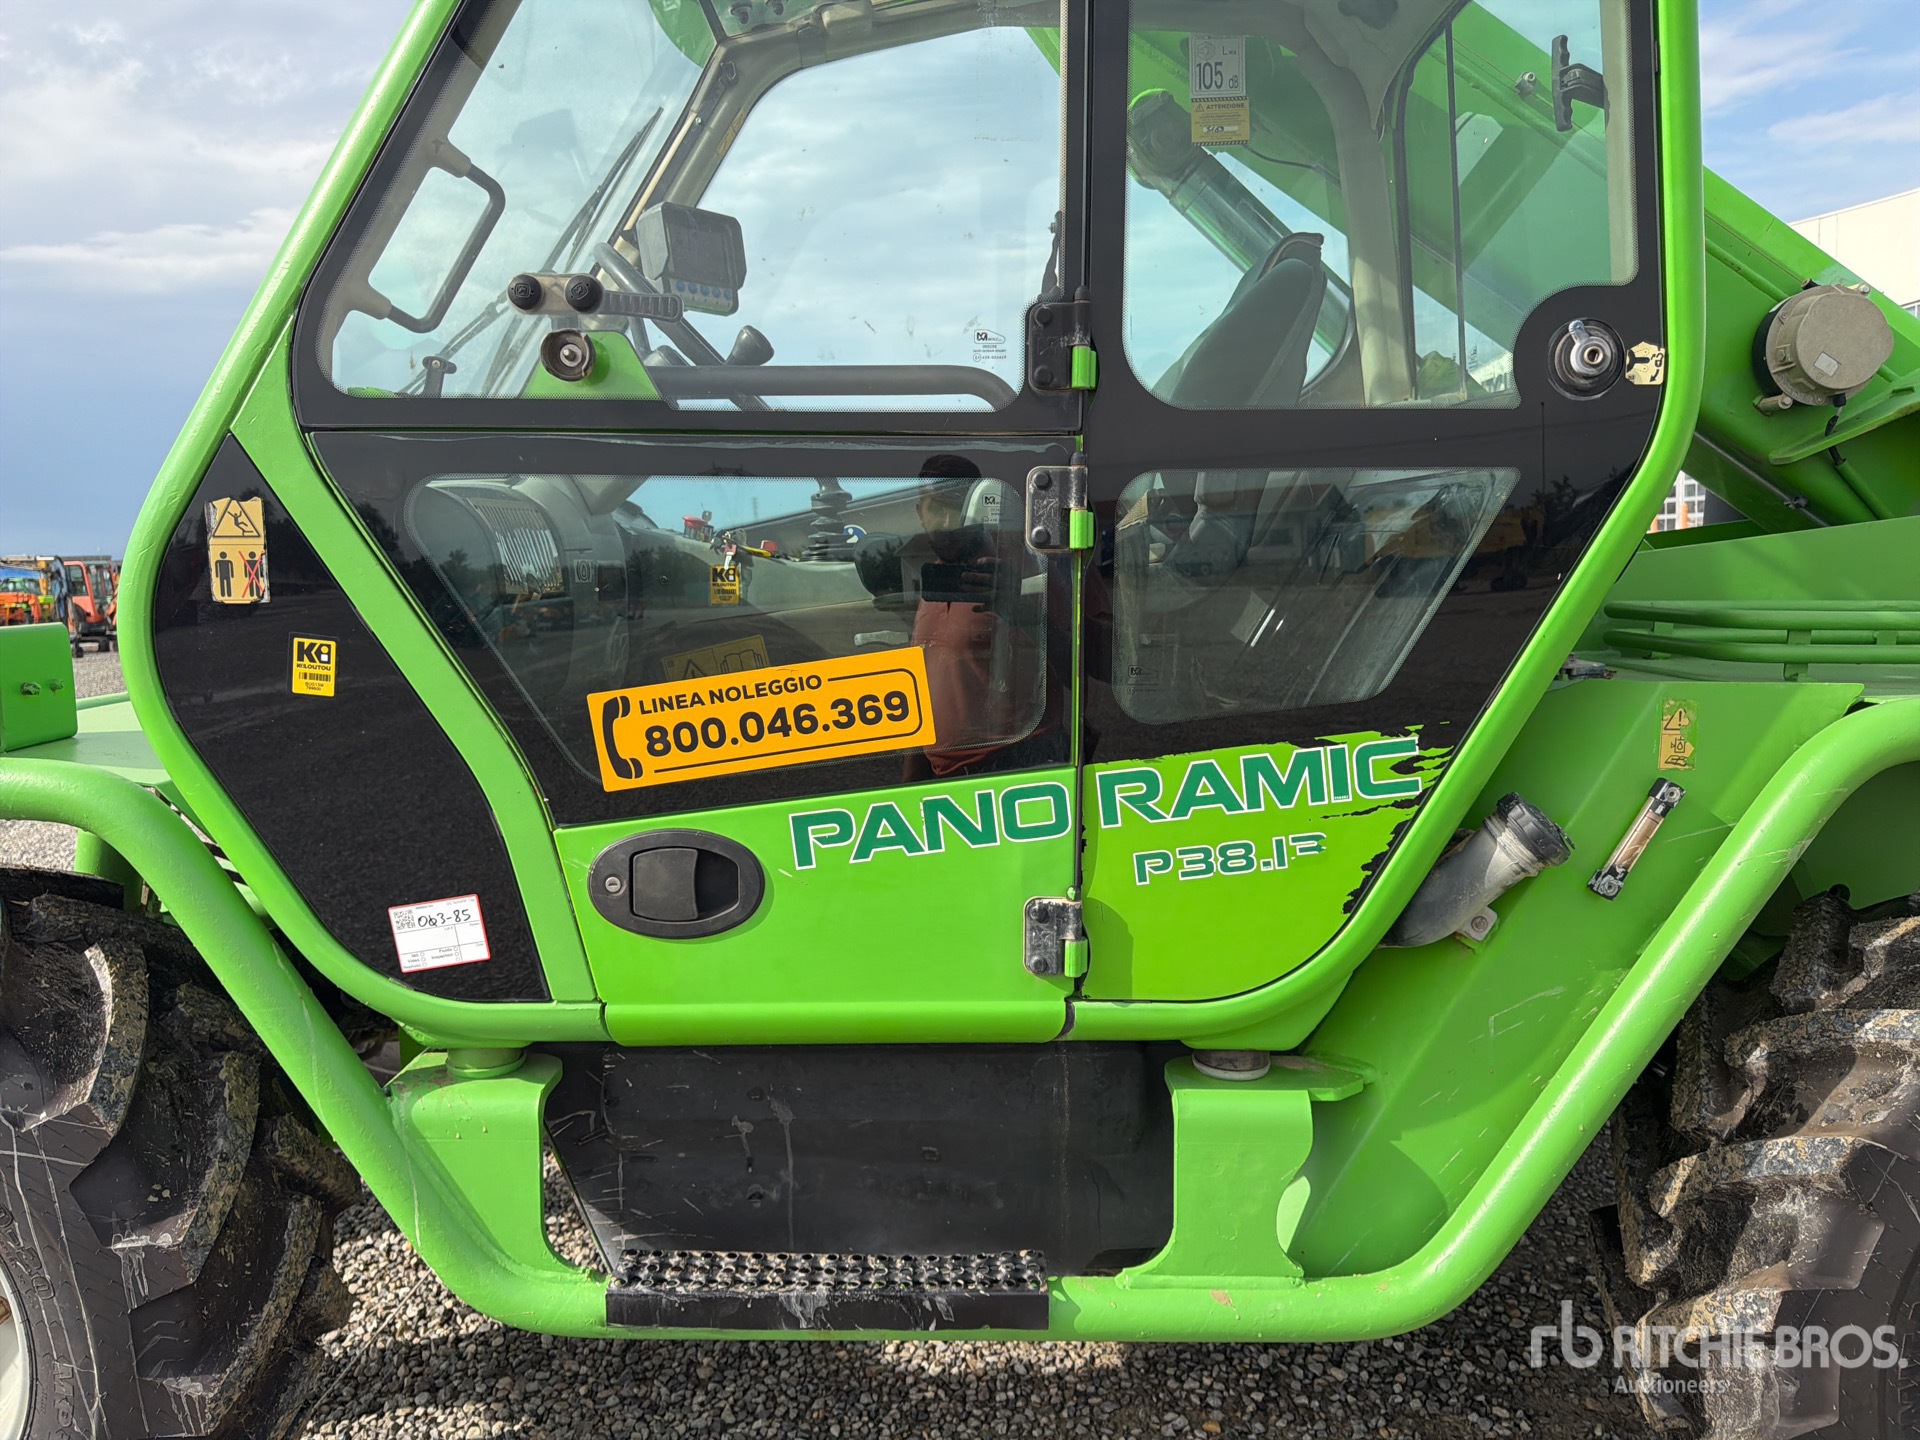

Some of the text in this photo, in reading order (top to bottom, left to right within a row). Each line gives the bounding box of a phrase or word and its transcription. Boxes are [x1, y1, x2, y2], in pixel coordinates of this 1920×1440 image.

[1196, 61, 1224, 90] 105
[1206, 102, 1245, 110] ATTENZIONE
[639, 674, 823, 715] LINEA NOLEGGIO
[645, 690, 910, 757] 800.046.369
